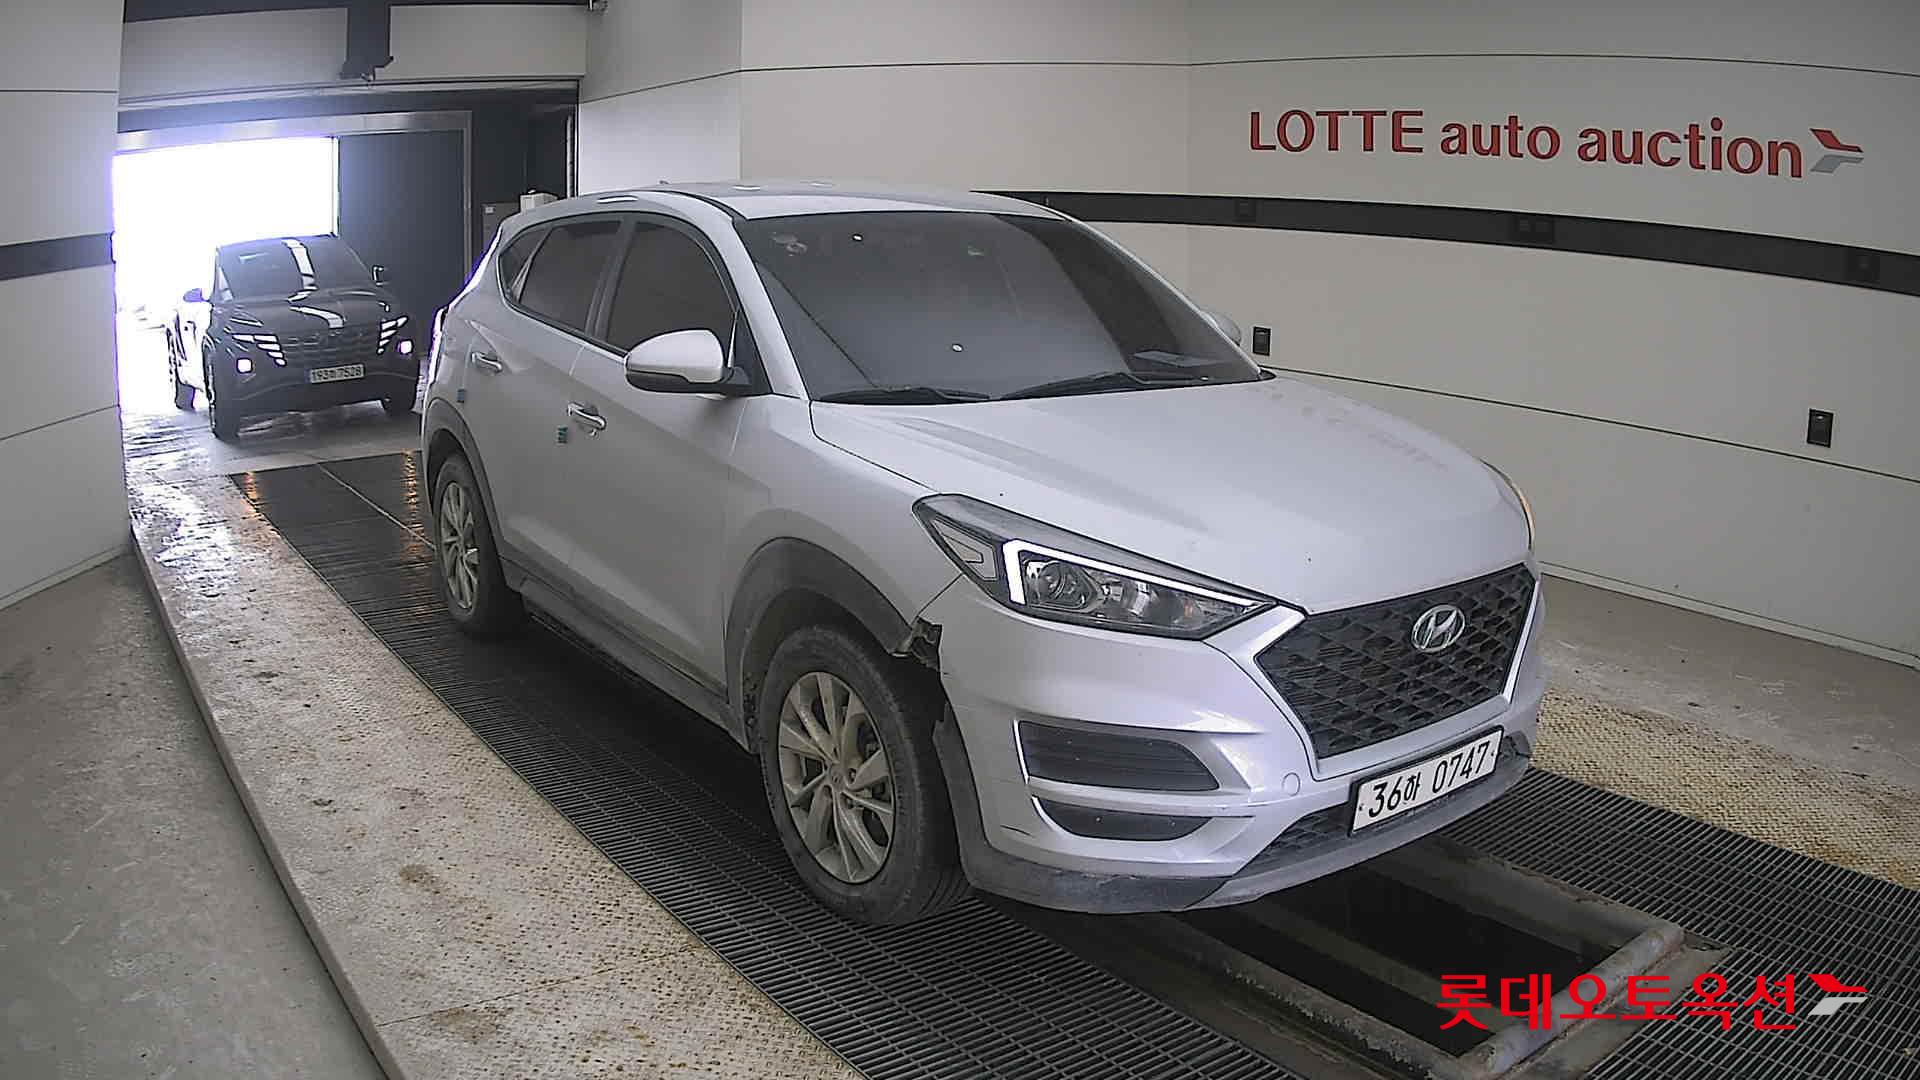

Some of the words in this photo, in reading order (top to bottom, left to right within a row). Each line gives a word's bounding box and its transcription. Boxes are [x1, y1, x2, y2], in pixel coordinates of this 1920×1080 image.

[1249, 110, 1424, 153] LOTTE
[1440, 115, 1560, 160] auto
[1577, 116, 1803, 178] auction
[1368, 771, 1421, 818] 36하
[1432, 740, 1491, 794] 0747
